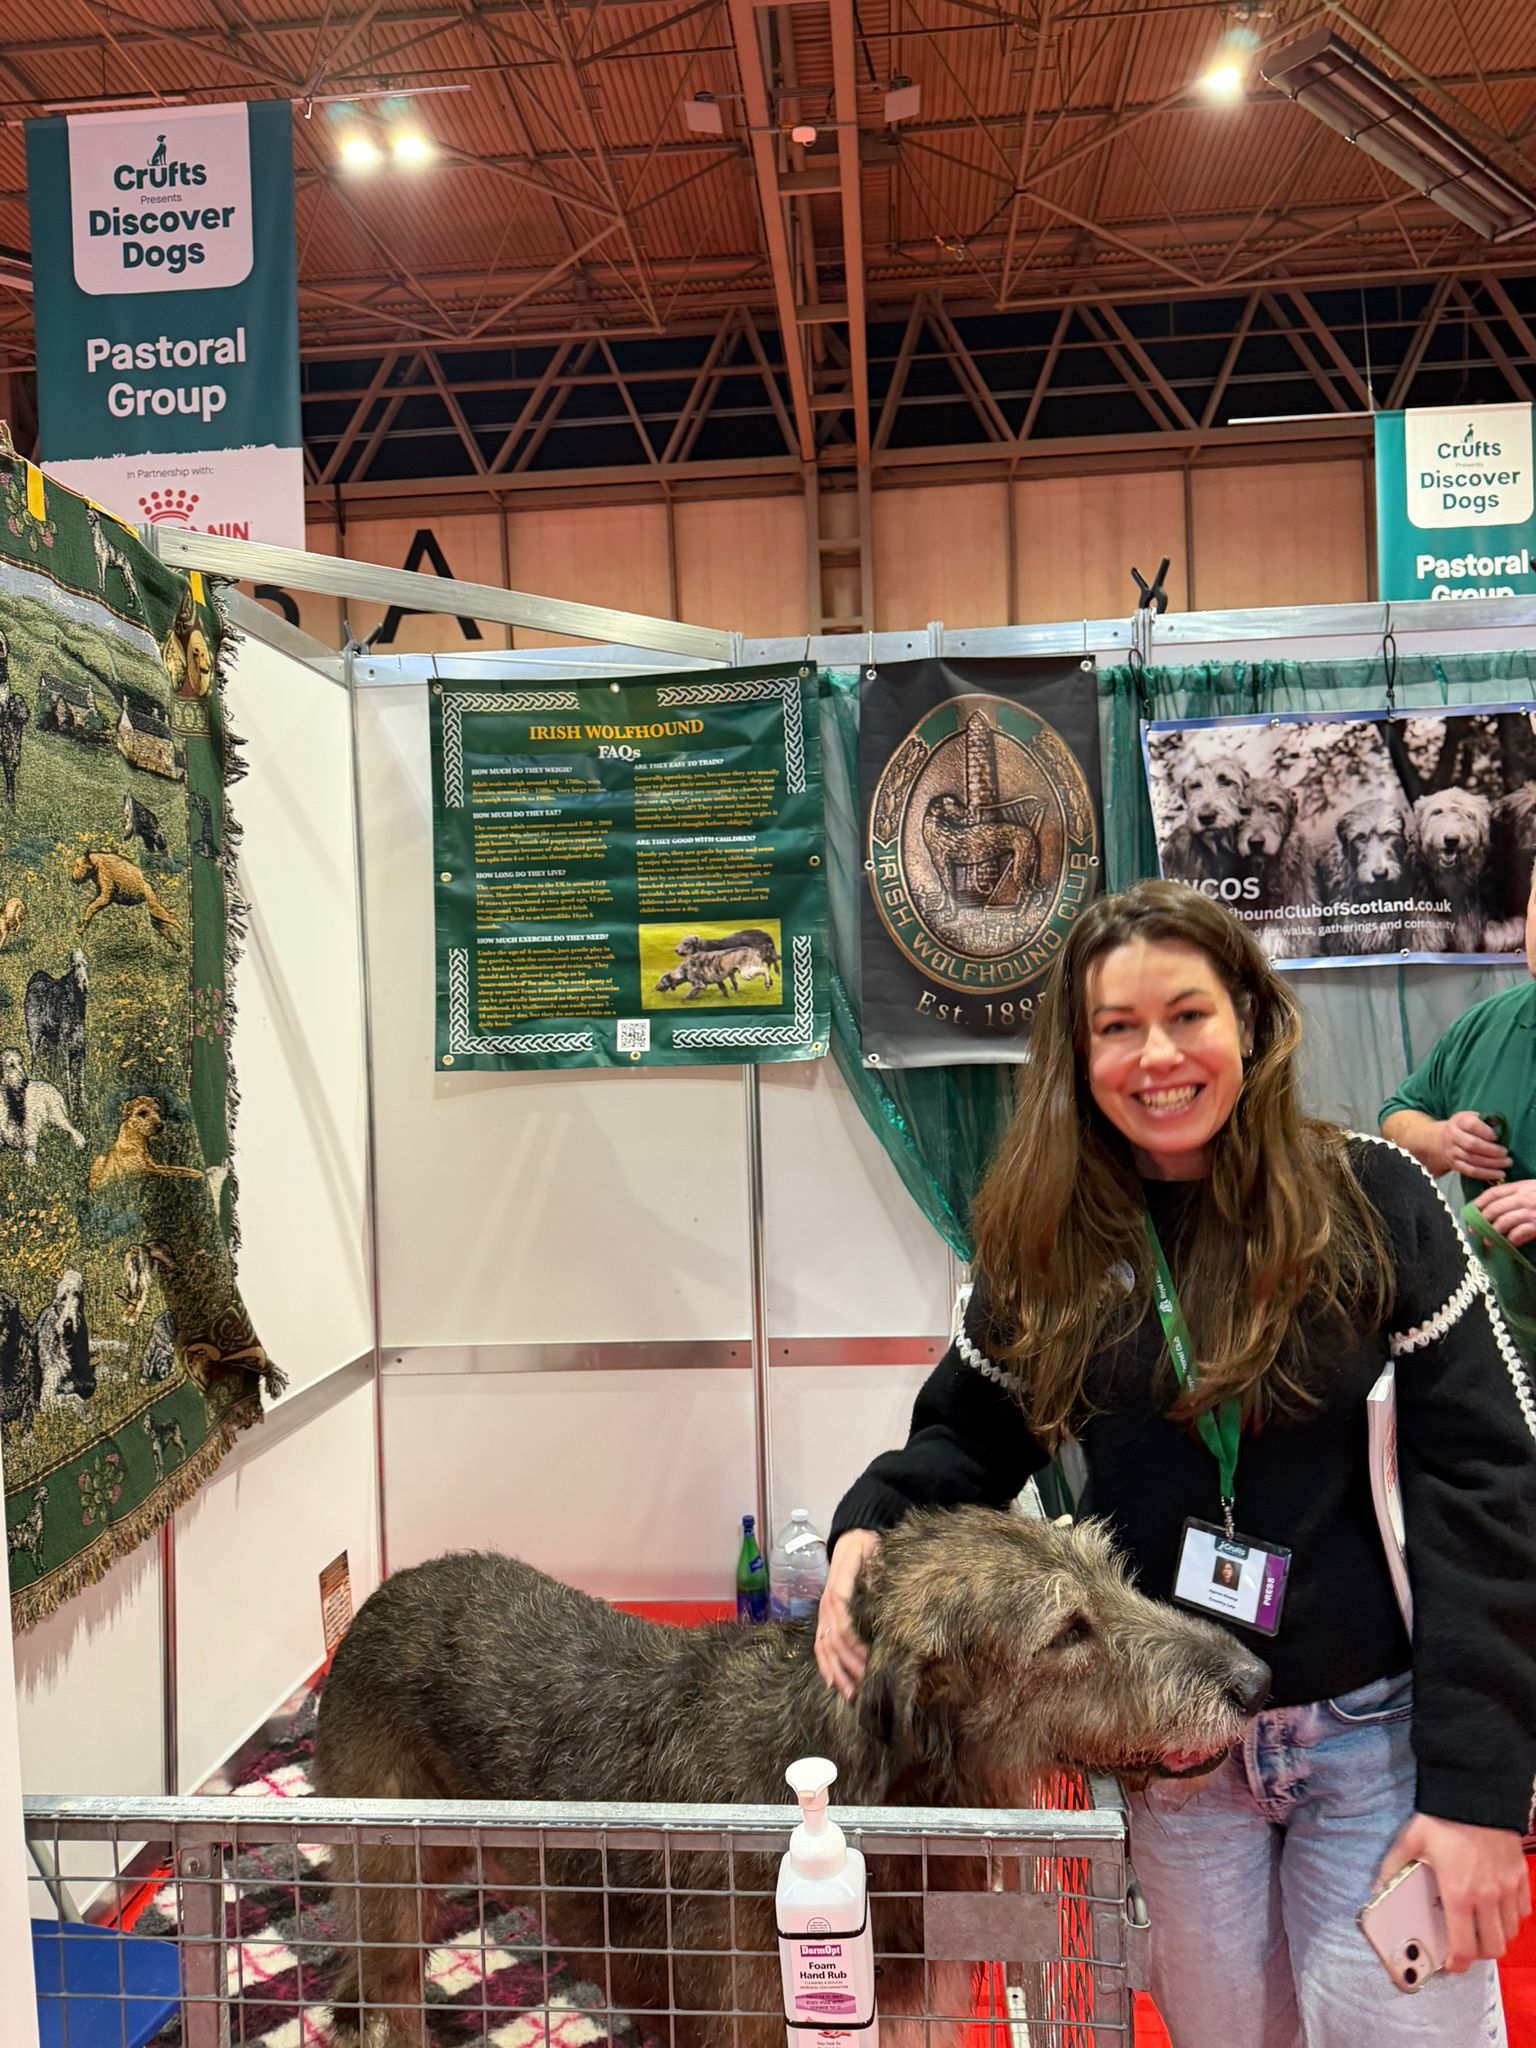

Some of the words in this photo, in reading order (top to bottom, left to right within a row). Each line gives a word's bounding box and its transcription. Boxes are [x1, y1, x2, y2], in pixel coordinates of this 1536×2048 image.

[114, 160, 207, 191] Crufts
[140, 192, 182, 205] Presents
[89, 204, 235, 238] Discover
[122, 239, 206, 274] Dogs
[87, 327, 246, 373] Pastoral
[107, 382, 226, 422] Group
[1437, 441, 1502, 459] Crufts
[127, 471, 135, 479] In
[137, 467, 189, 479] Partnership
[191, 466, 214, 475] with:
[1420, 470, 1521, 489] Discover
[1443, 493, 1499, 514] Dogs
[1416, 549, 1529, 579] Pastoral
[376, 529, 483, 644] A
[529, 725, 581, 740] IRISH
[585, 719, 704, 740] WOLFHOUND
[598, 745, 641, 761] FAQs
[1168, 877, 1261, 901] COS
[877, 853, 914, 929] IRISH
[913, 929, 1062, 985] WOLFHOUND
[1057, 852, 1090, 921] CLUB
[1318, 920, 1378, 937] gatherings
[1380, 918, 1402, 930] and
[914, 990, 970, 1025] Est.
[1263, 1577, 1275, 1607] PRESS
[800, 1971, 825, 1980] Hand
[828, 1970, 847, 1979] Rub
[809, 1962, 836, 1970] Foam
